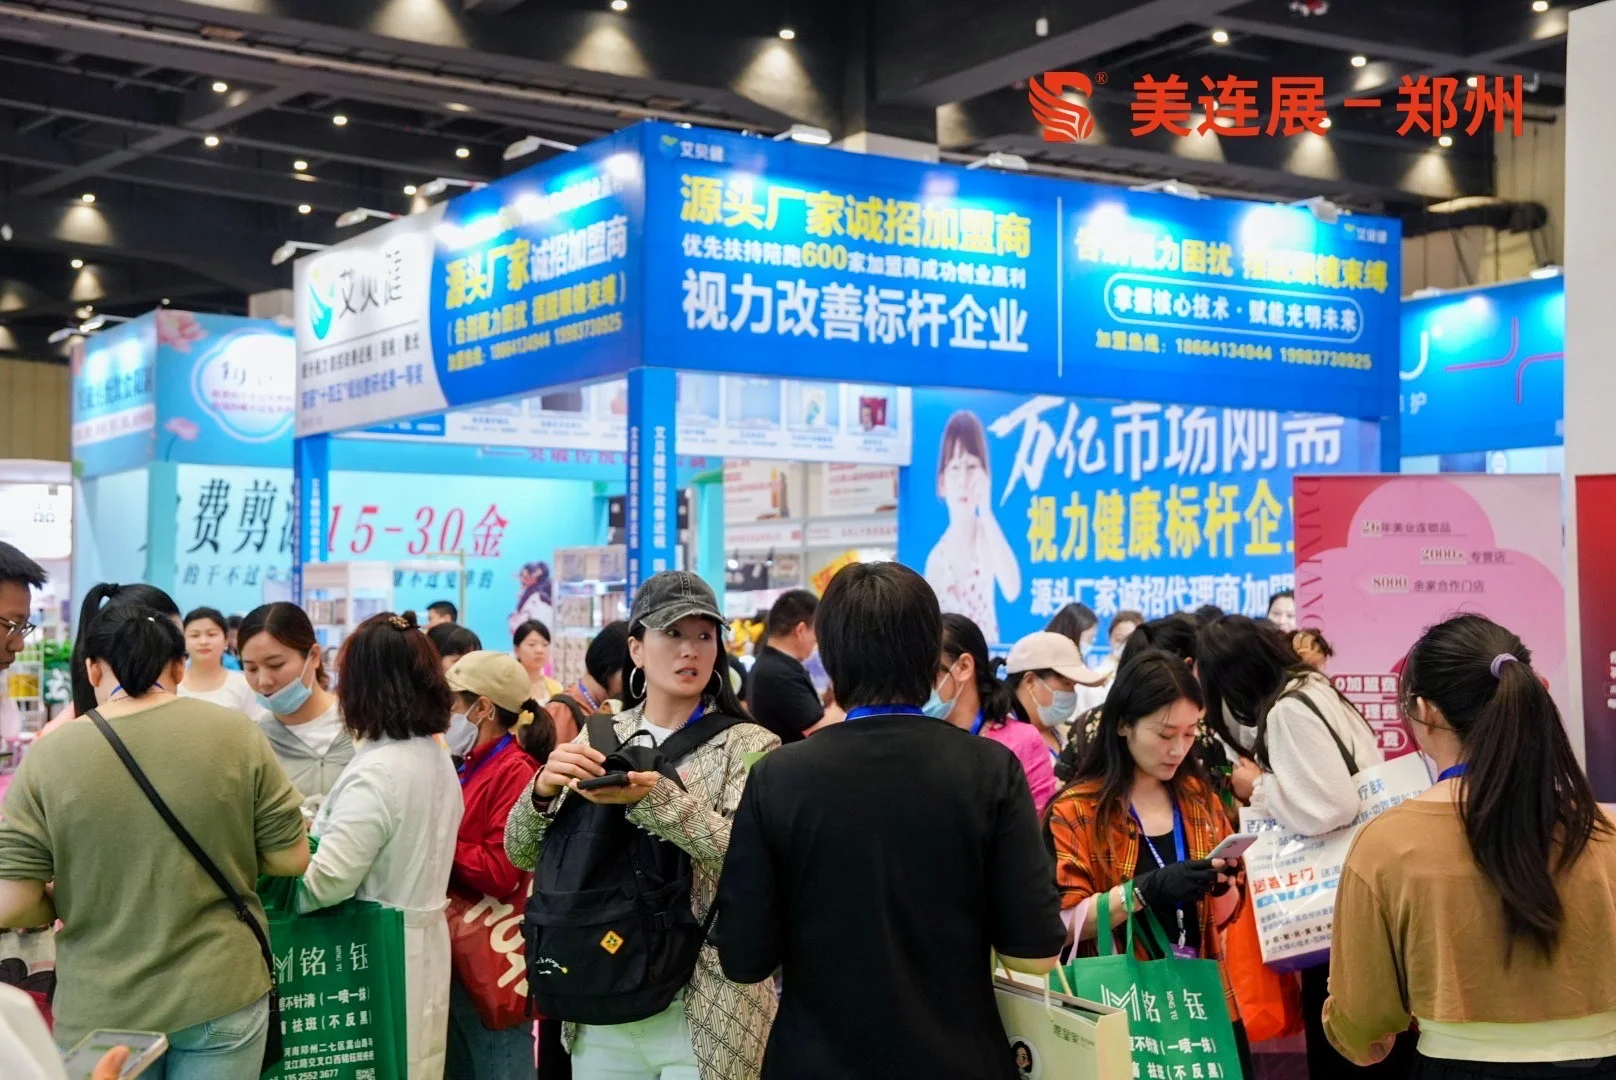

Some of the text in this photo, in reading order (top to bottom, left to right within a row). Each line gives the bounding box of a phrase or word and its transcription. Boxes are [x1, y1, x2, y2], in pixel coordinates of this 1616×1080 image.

[680, 173, 1031, 259] 源头厂家诚招加盟商
[681, 267, 1029, 353] 视力改善标杆企业
[1026, 478, 1293, 564] 视力健康标杆企
[299, 946, 326, 977] 铭
